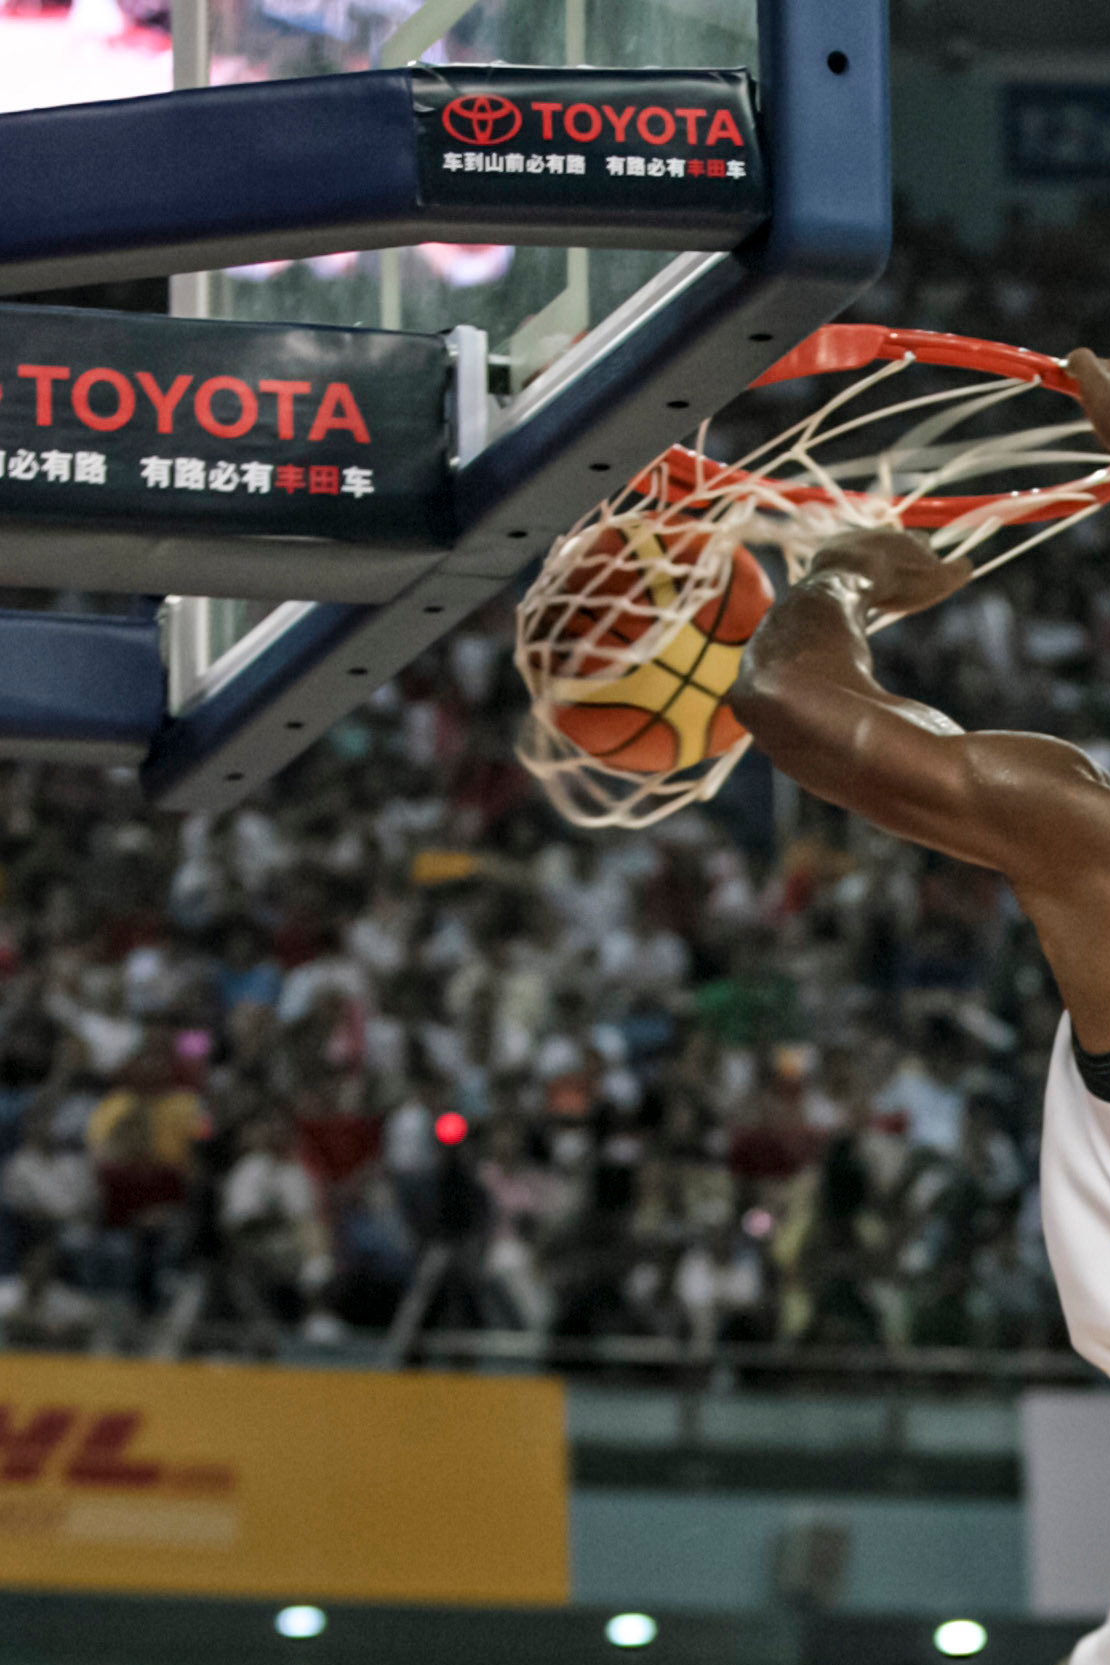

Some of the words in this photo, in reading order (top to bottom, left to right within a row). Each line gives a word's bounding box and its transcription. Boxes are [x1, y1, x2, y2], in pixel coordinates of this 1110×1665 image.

[531, 103, 744, 147] TOYOTA
[442, 152, 587, 176] 车到山前必有路
[605, 156, 747, 180] 有路必有丰田车
[17, 364, 371, 444] TOYOTA
[0, 449, 107, 484] 必有路
[140, 456, 375, 499] 有路必有丰田车
